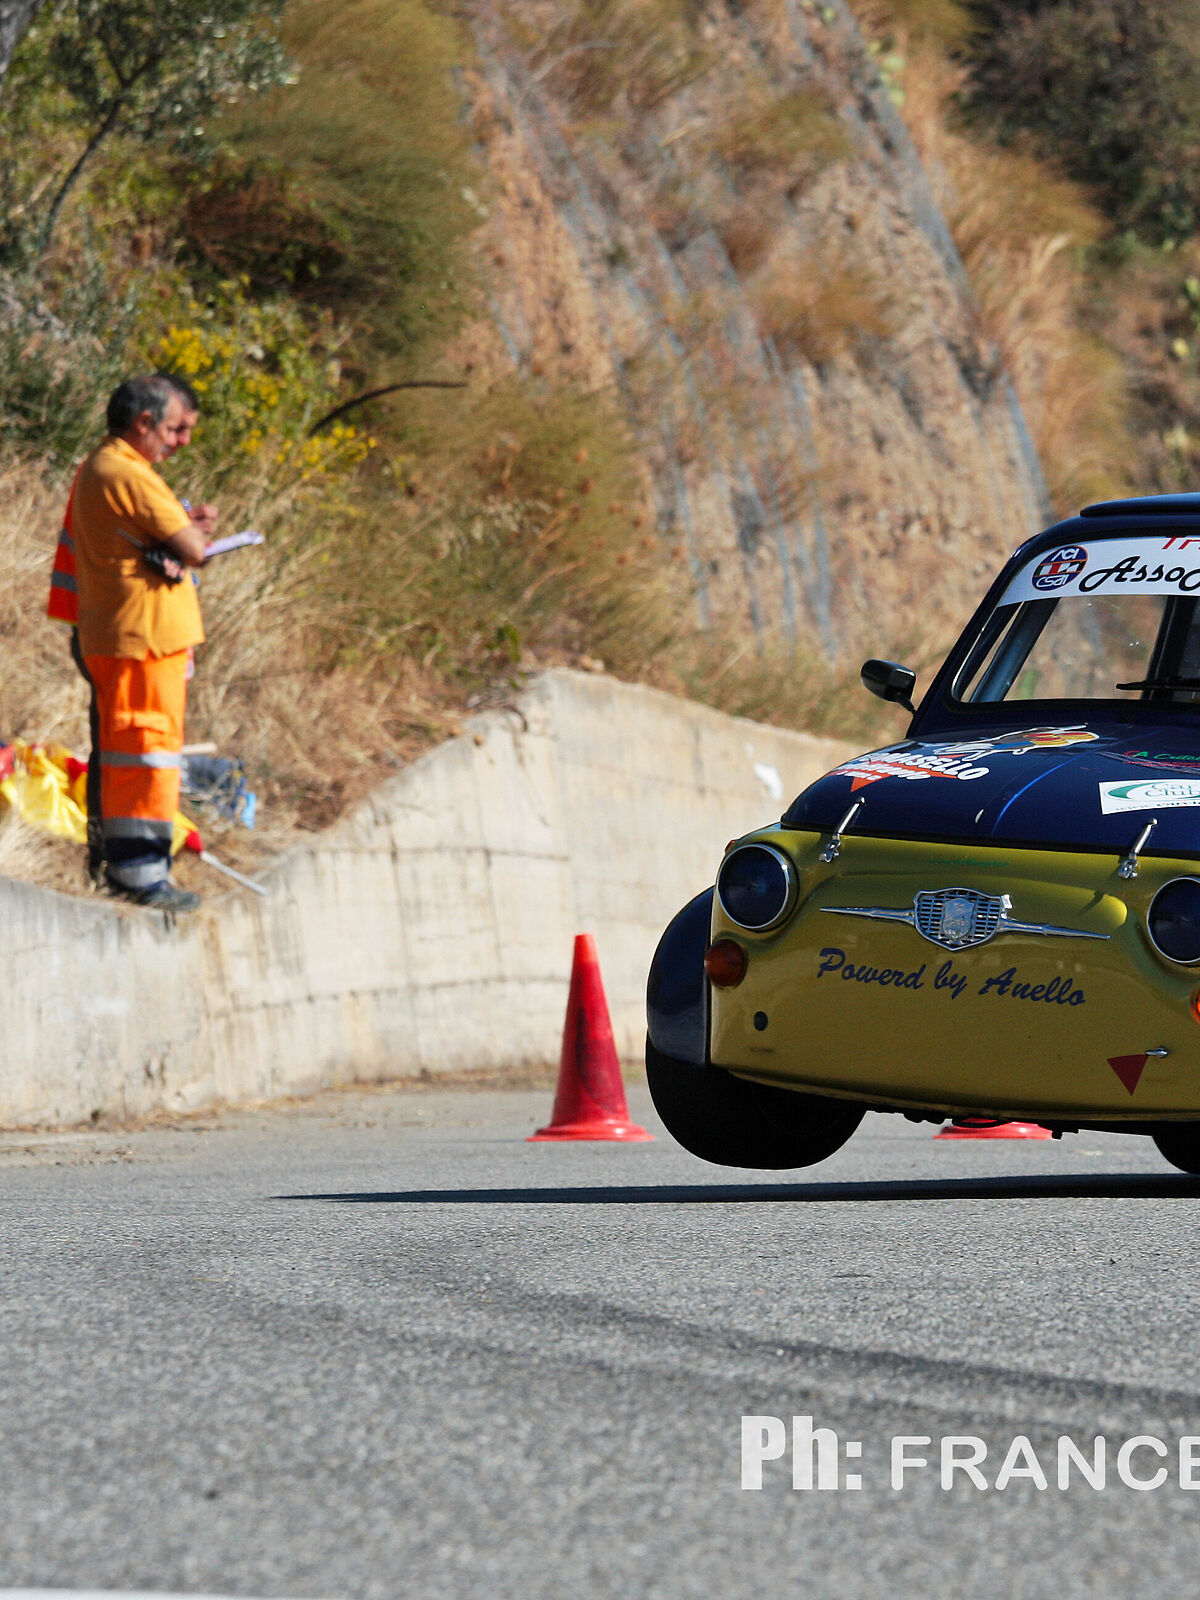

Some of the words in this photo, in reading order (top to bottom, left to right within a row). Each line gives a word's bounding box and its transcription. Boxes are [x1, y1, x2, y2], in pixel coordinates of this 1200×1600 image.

[816, 947, 927, 990] Powerd
[934, 960, 967, 999] by
[978, 967, 1086, 1006] Anello
